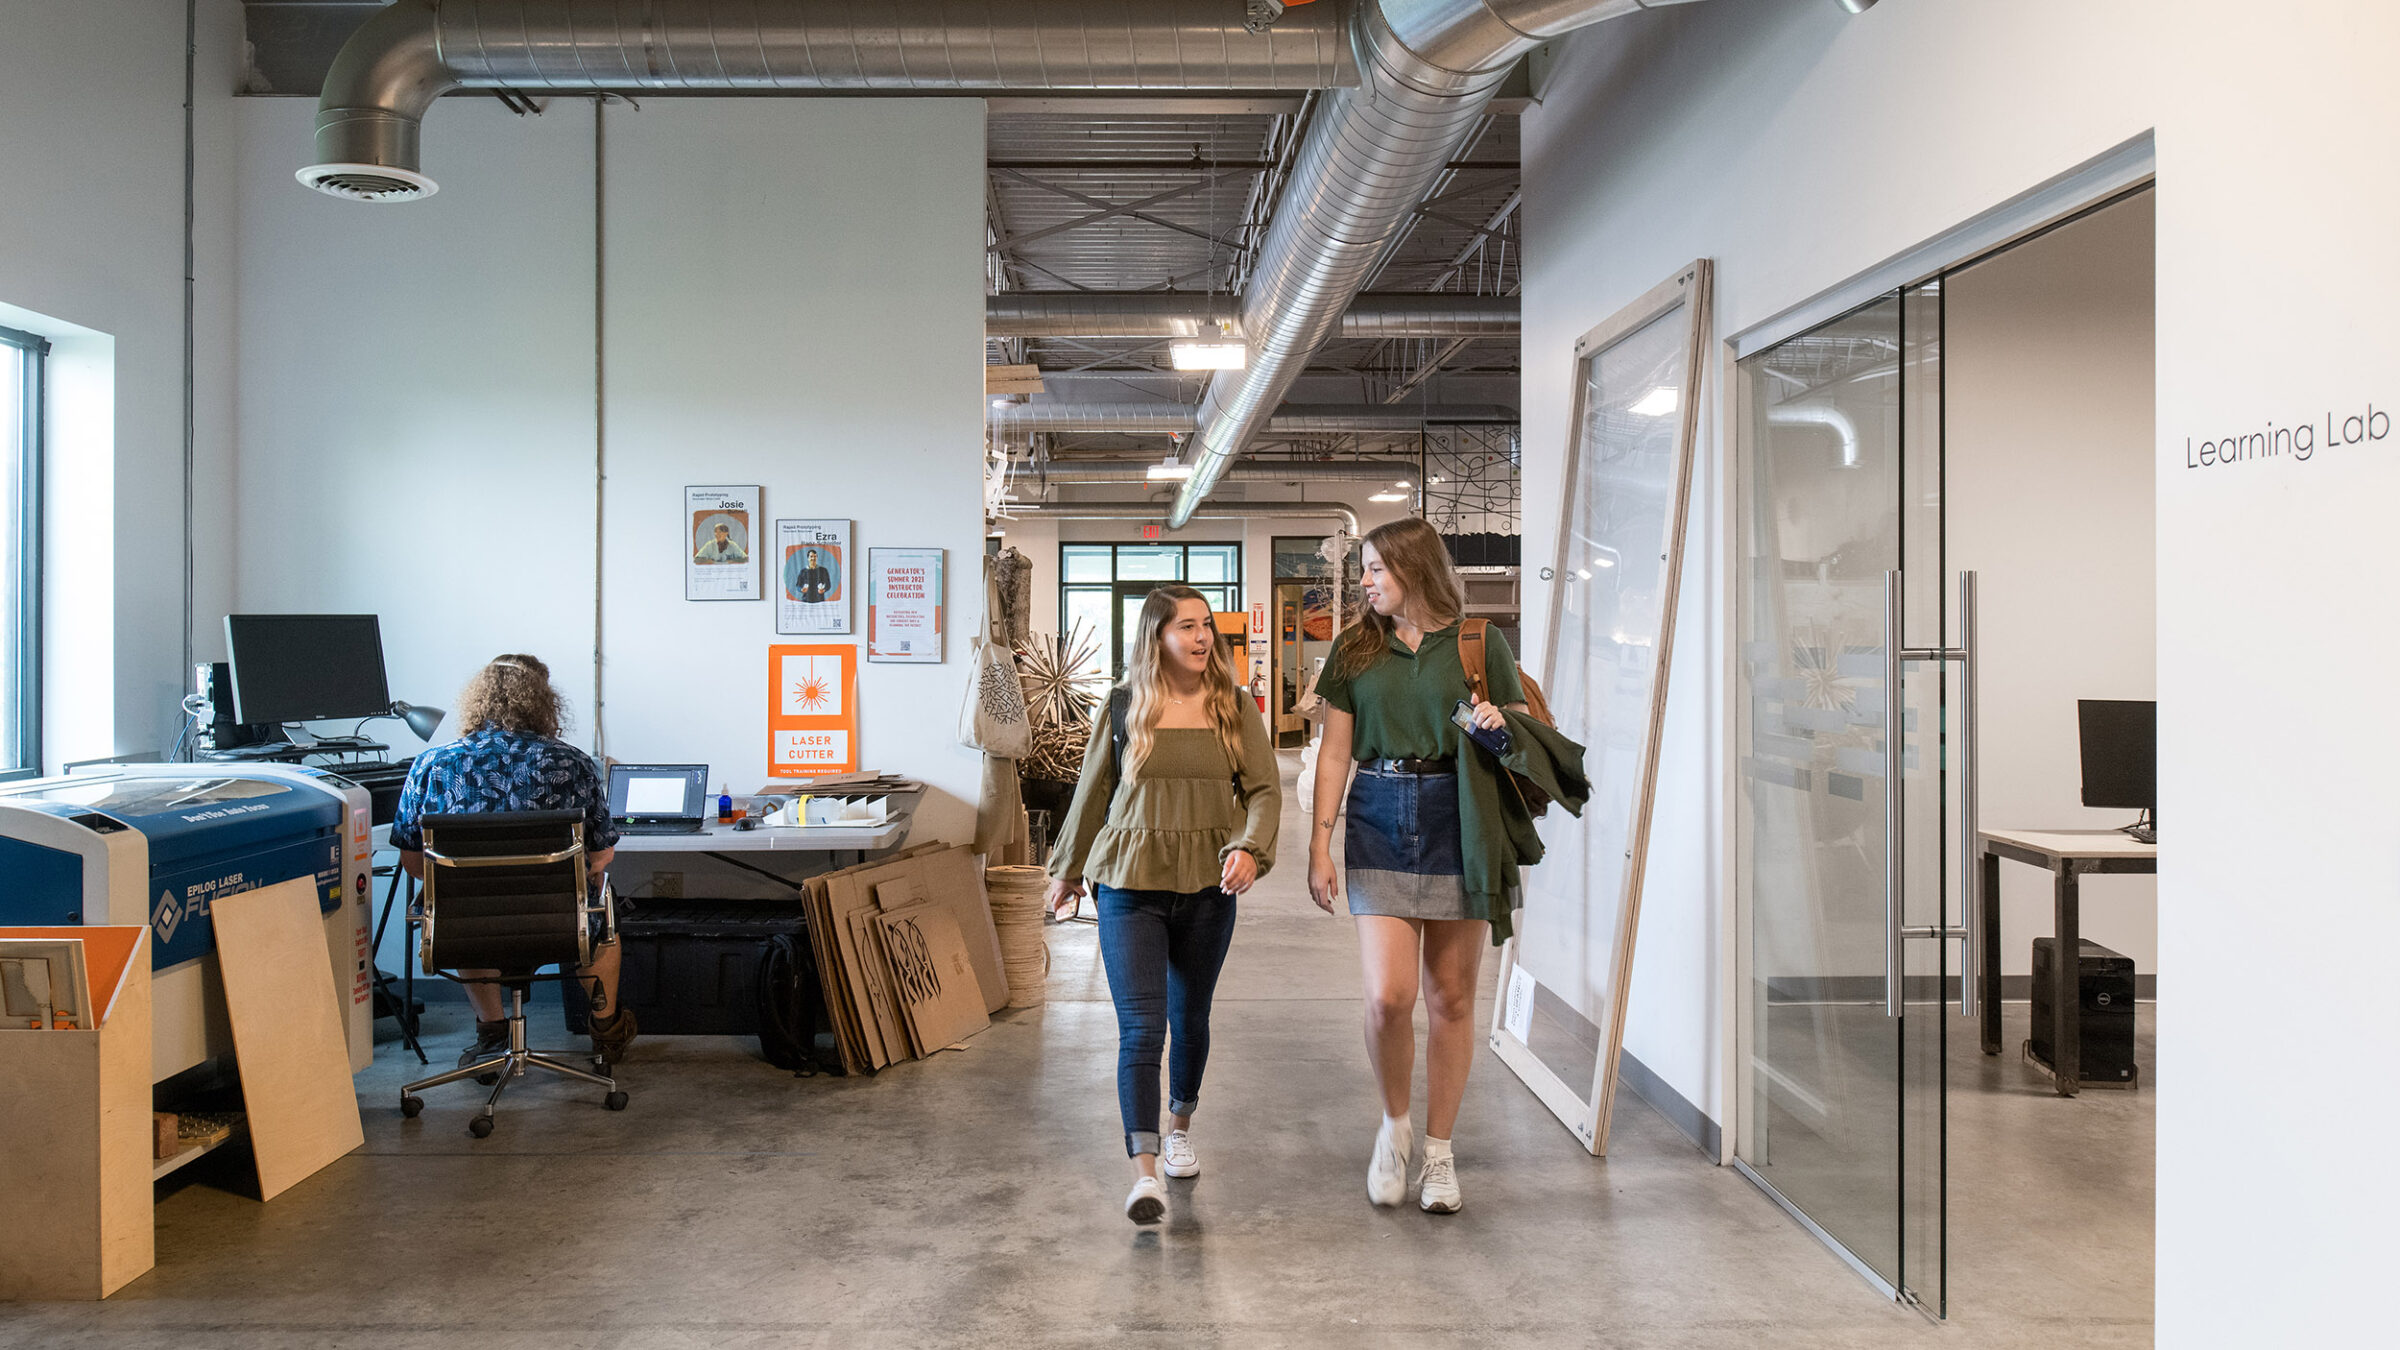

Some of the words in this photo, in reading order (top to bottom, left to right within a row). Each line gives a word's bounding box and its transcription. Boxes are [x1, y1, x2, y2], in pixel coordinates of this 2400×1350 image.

[2187, 421, 2313, 468] Learning
[2327, 403, 2390, 447] Lab
[719, 500, 744, 509] Josie
[815, 532, 837, 541] Ezra
[1143, 525, 1160, 539] EXIT
[791, 736, 831, 746] LASER
[788, 750, 834, 759] CUTTER
[187, 880, 216, 897] EPILOG
[218, 872, 243, 888] LASER
